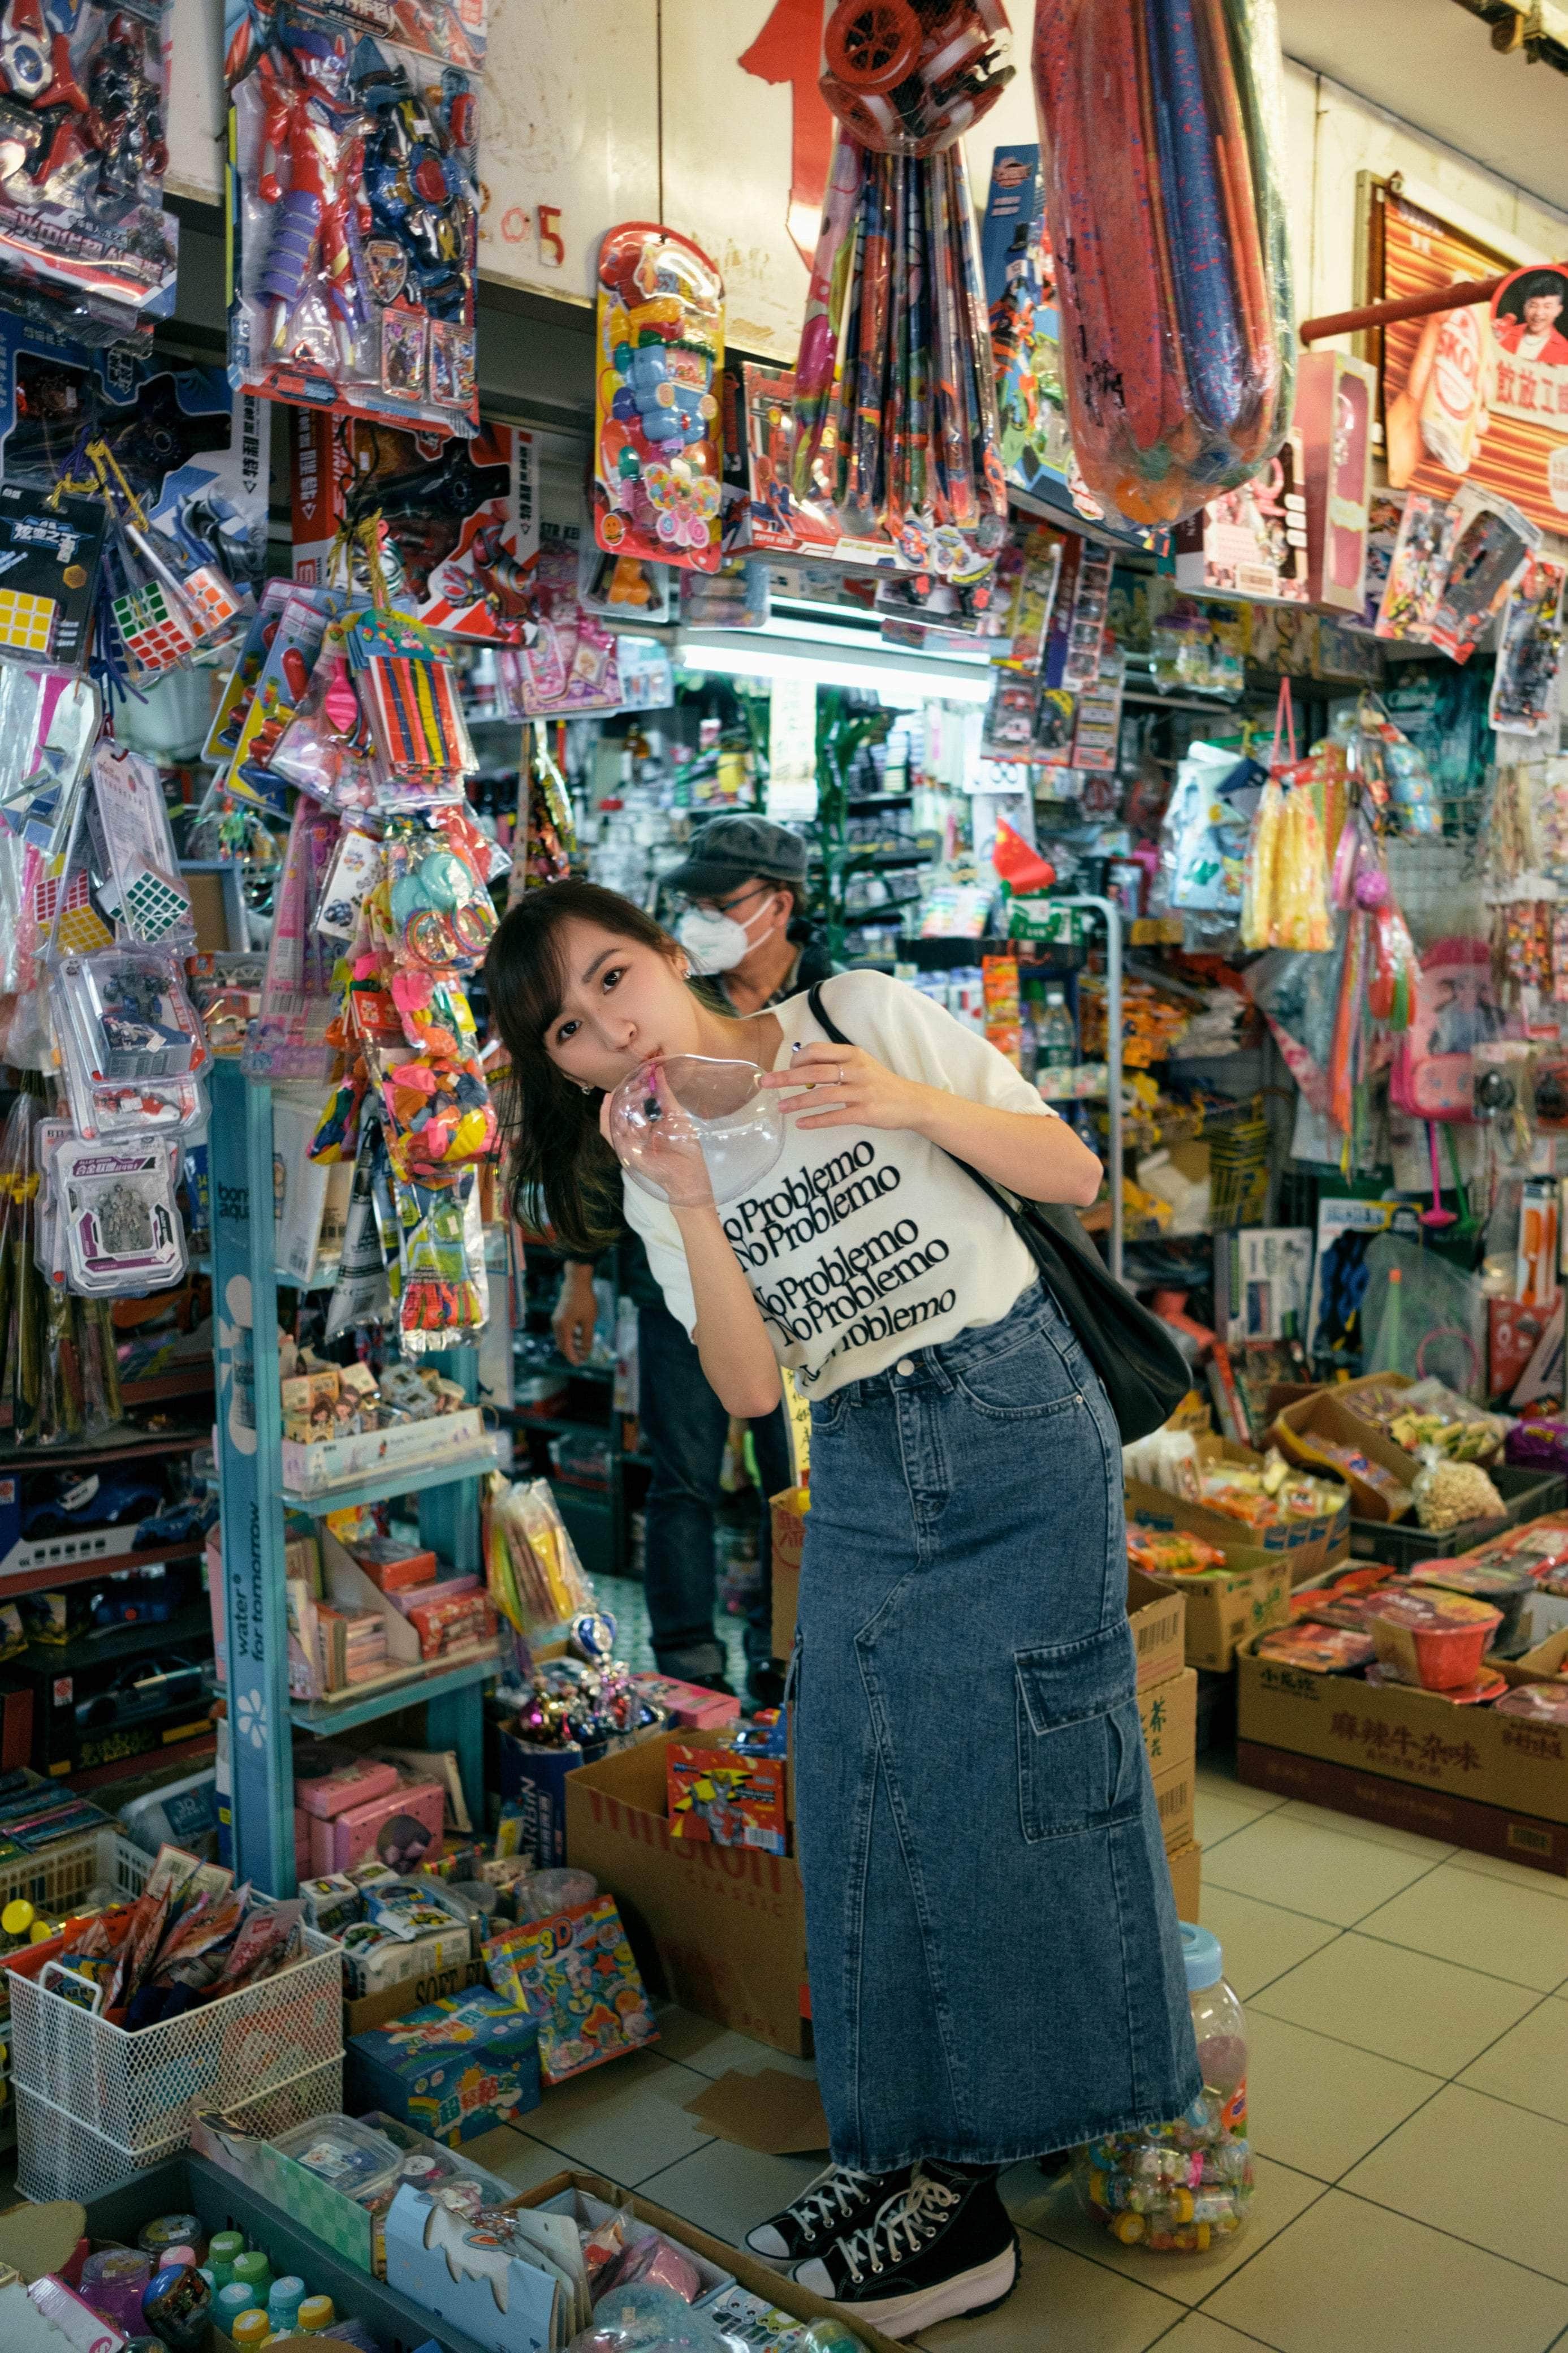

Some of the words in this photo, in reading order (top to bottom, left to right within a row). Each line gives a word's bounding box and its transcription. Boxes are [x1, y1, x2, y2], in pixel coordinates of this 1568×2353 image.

[722, 1216, 744, 1243] o
[736, 1140, 875, 1234] Problemo
[761, 1165, 901, 1258] Problemo
[763, 1313, 813, 1347] No
[802, 1238, 951, 1335] Problemo
[776, 1218, 919, 1311] Problemo
[839, 1288, 957, 1353] roblemo
[250, 1501, 264, 1623] tomorrow
[235, 1587, 249, 1657] water
[252, 1627, 265, 1663] for
